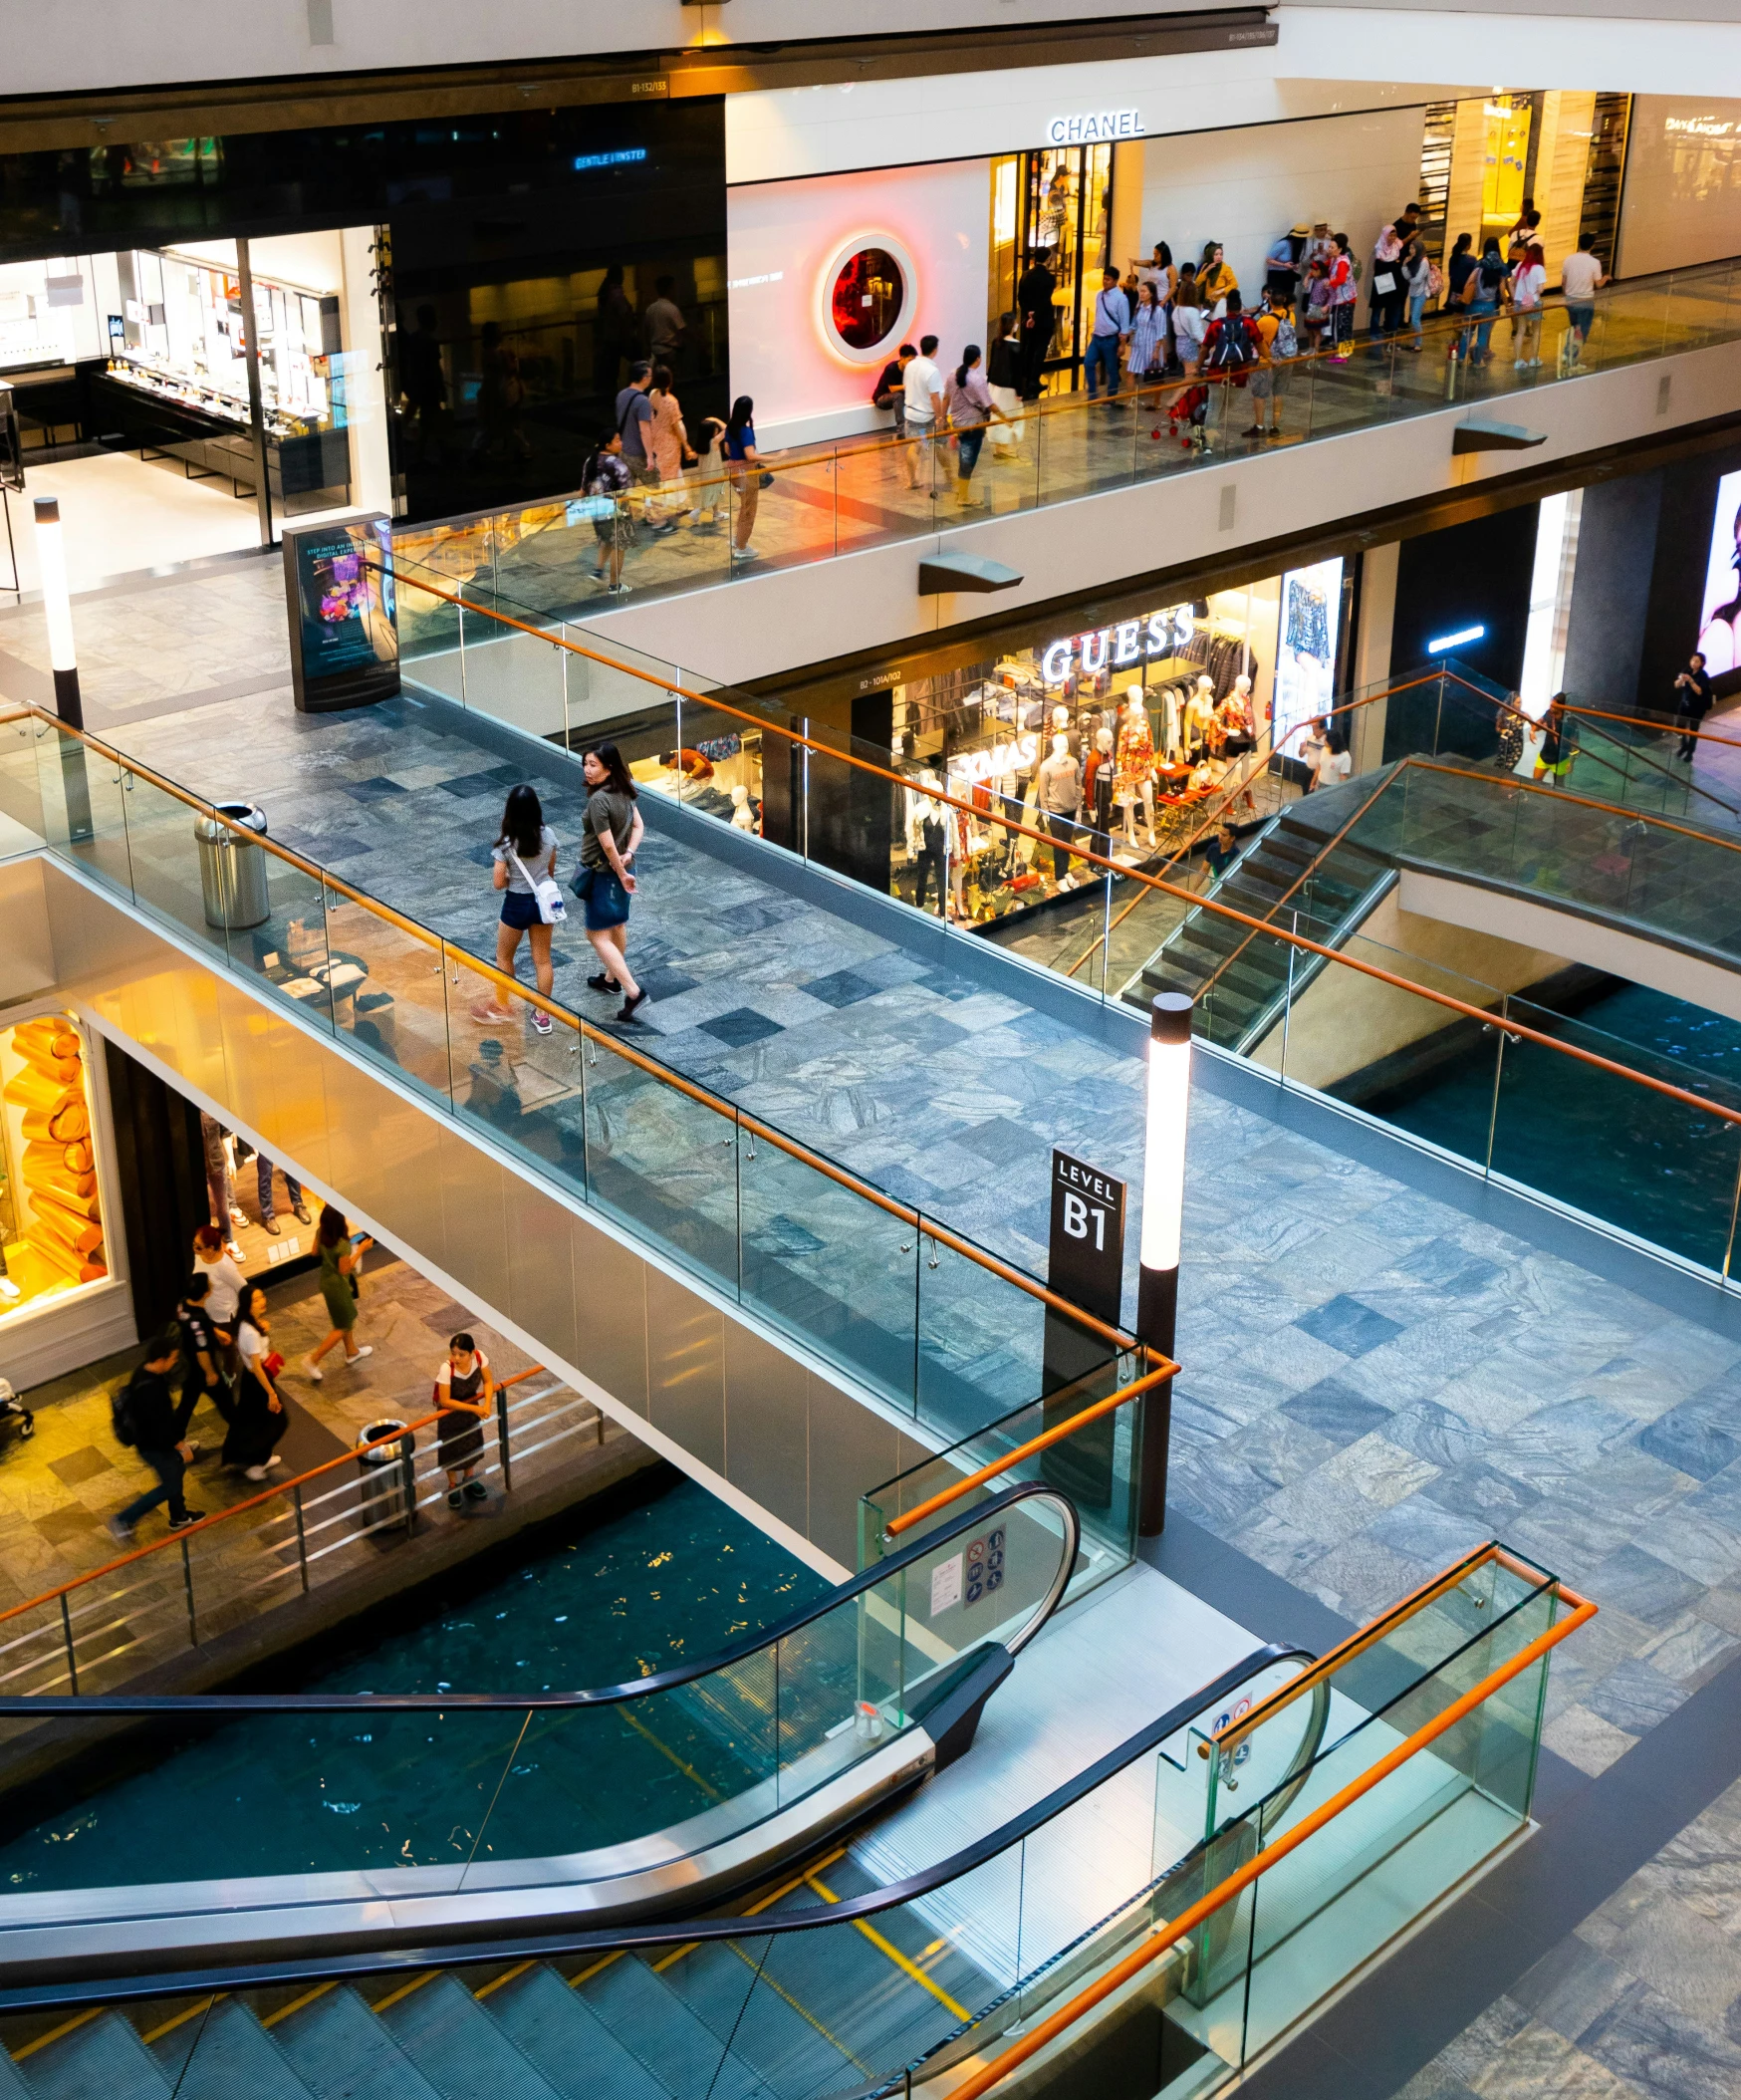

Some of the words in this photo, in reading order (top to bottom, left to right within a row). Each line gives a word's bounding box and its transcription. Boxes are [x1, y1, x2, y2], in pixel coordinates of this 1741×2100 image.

[1051, 112, 1145, 142] CHANEL
[1042, 604, 1195, 683] GUESS
[952, 734, 1037, 783] XMAS
[1060, 1160, 1115, 1201] LEVEL
[1064, 1191, 1106, 1251] B1
